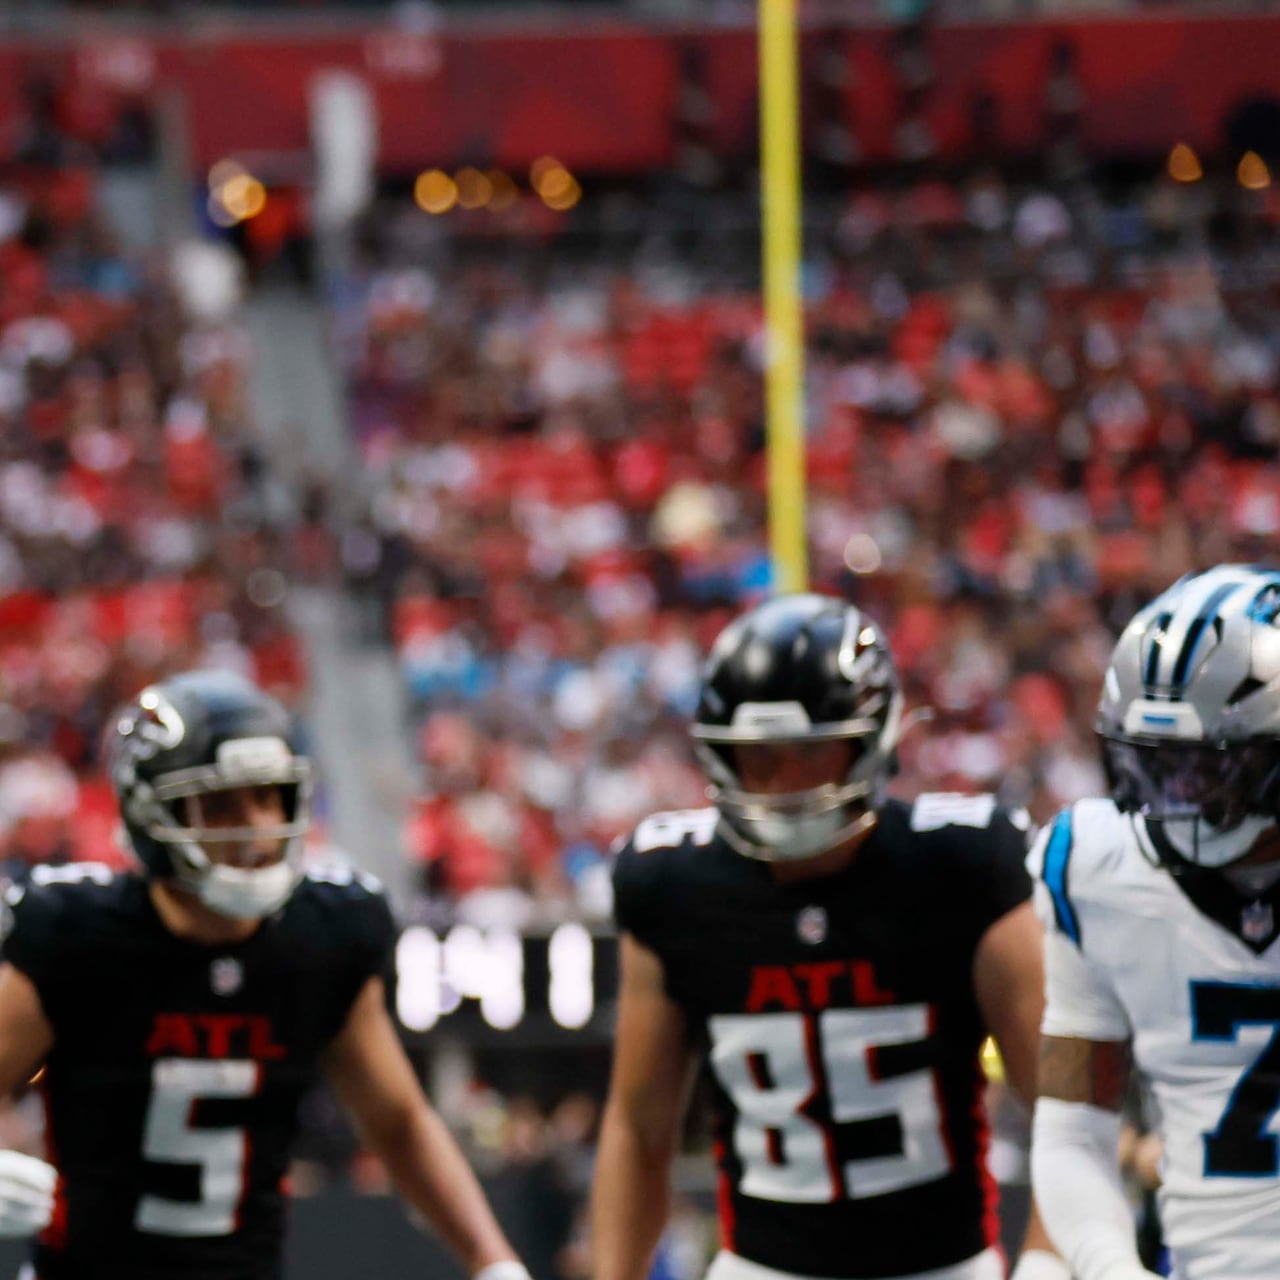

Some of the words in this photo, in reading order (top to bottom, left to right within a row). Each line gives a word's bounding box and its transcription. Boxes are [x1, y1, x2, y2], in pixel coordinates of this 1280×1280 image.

[146, 1014, 286, 1059] ATL
[746, 961, 892, 1011] ATL
[135, 1058, 267, 1237] 5
[709, 1004, 954, 1202] 85
[1189, 979, 1280, 1180] 7
